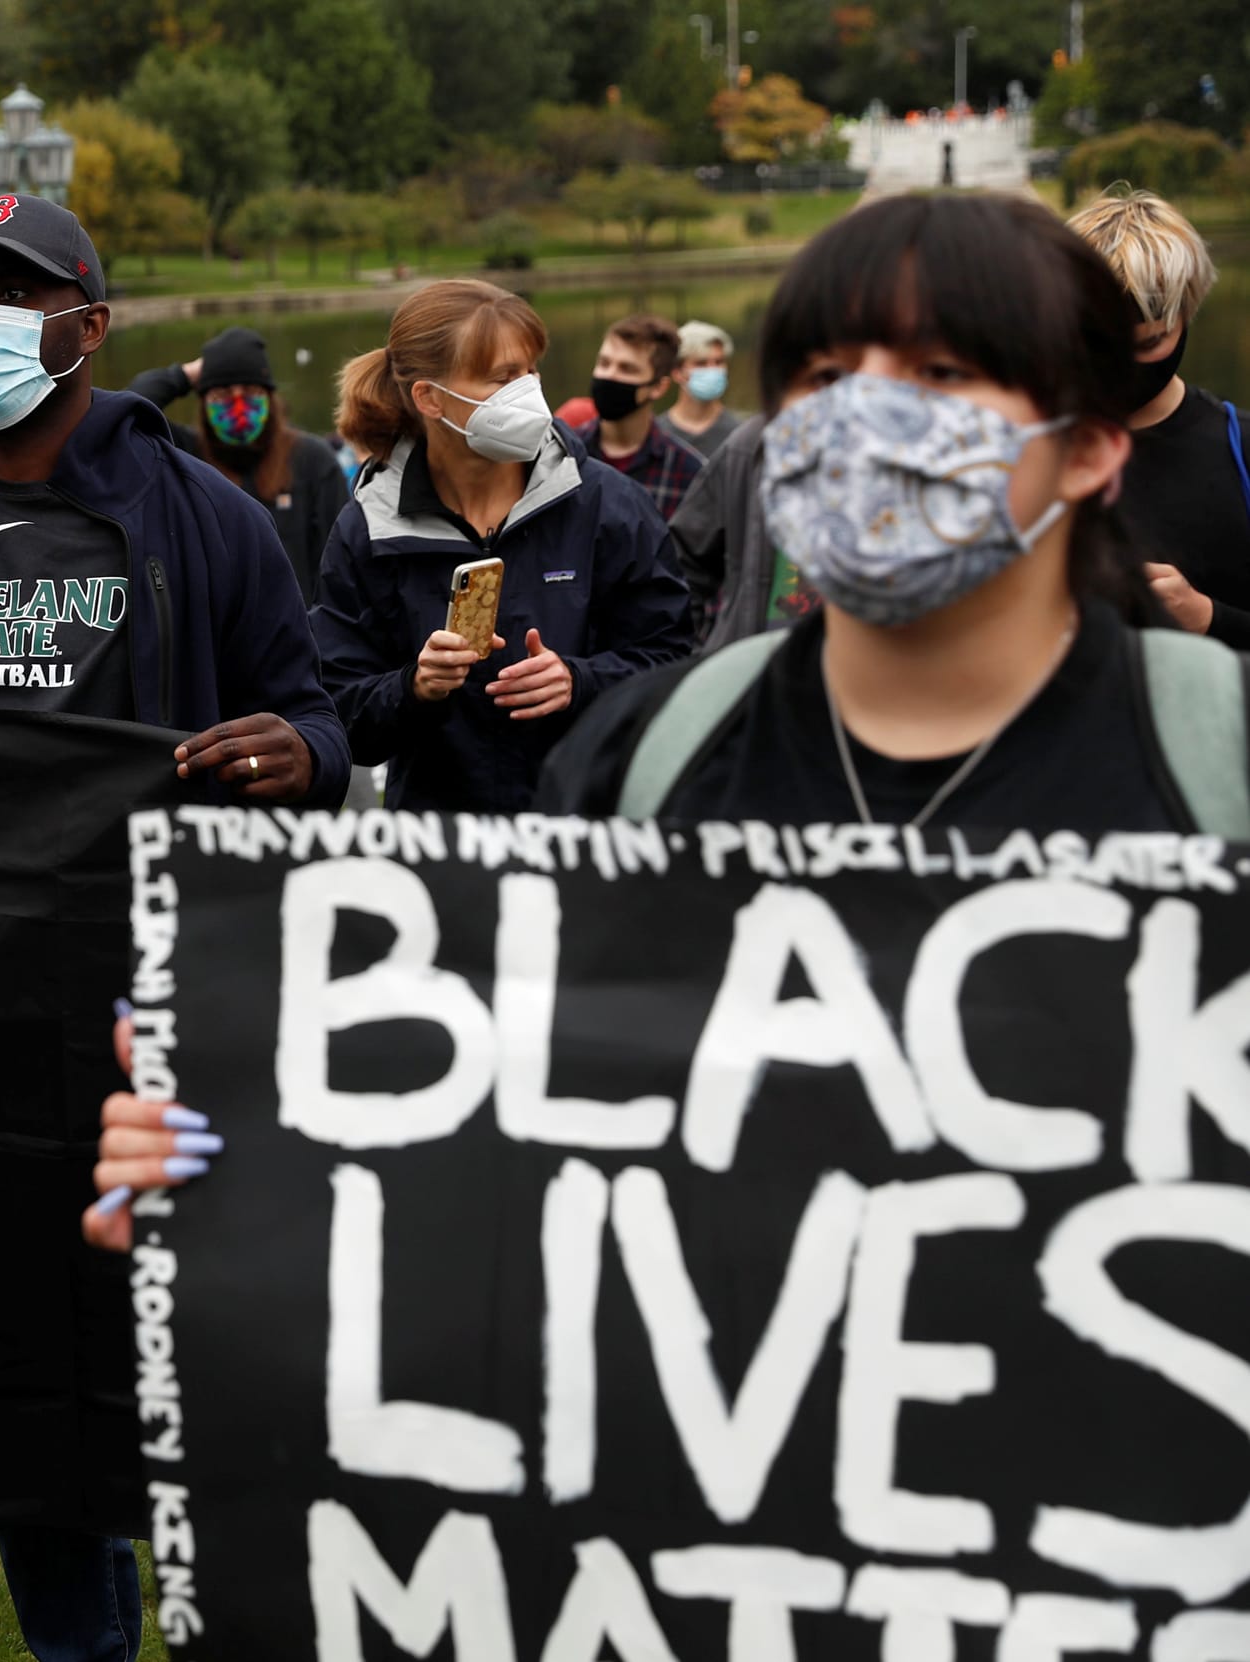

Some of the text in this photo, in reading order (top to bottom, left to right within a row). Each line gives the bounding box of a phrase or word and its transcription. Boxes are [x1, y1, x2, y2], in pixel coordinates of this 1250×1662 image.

[176, 805, 448, 864] TRAYVON
[455, 812, 670, 881] MARTIN
[275, 856, 1250, 1184] BLACK
[130, 1246, 185, 1461] RODNEY
[326, 1157, 1250, 1602] LIVES
[147, 1480, 205, 1646] KING
